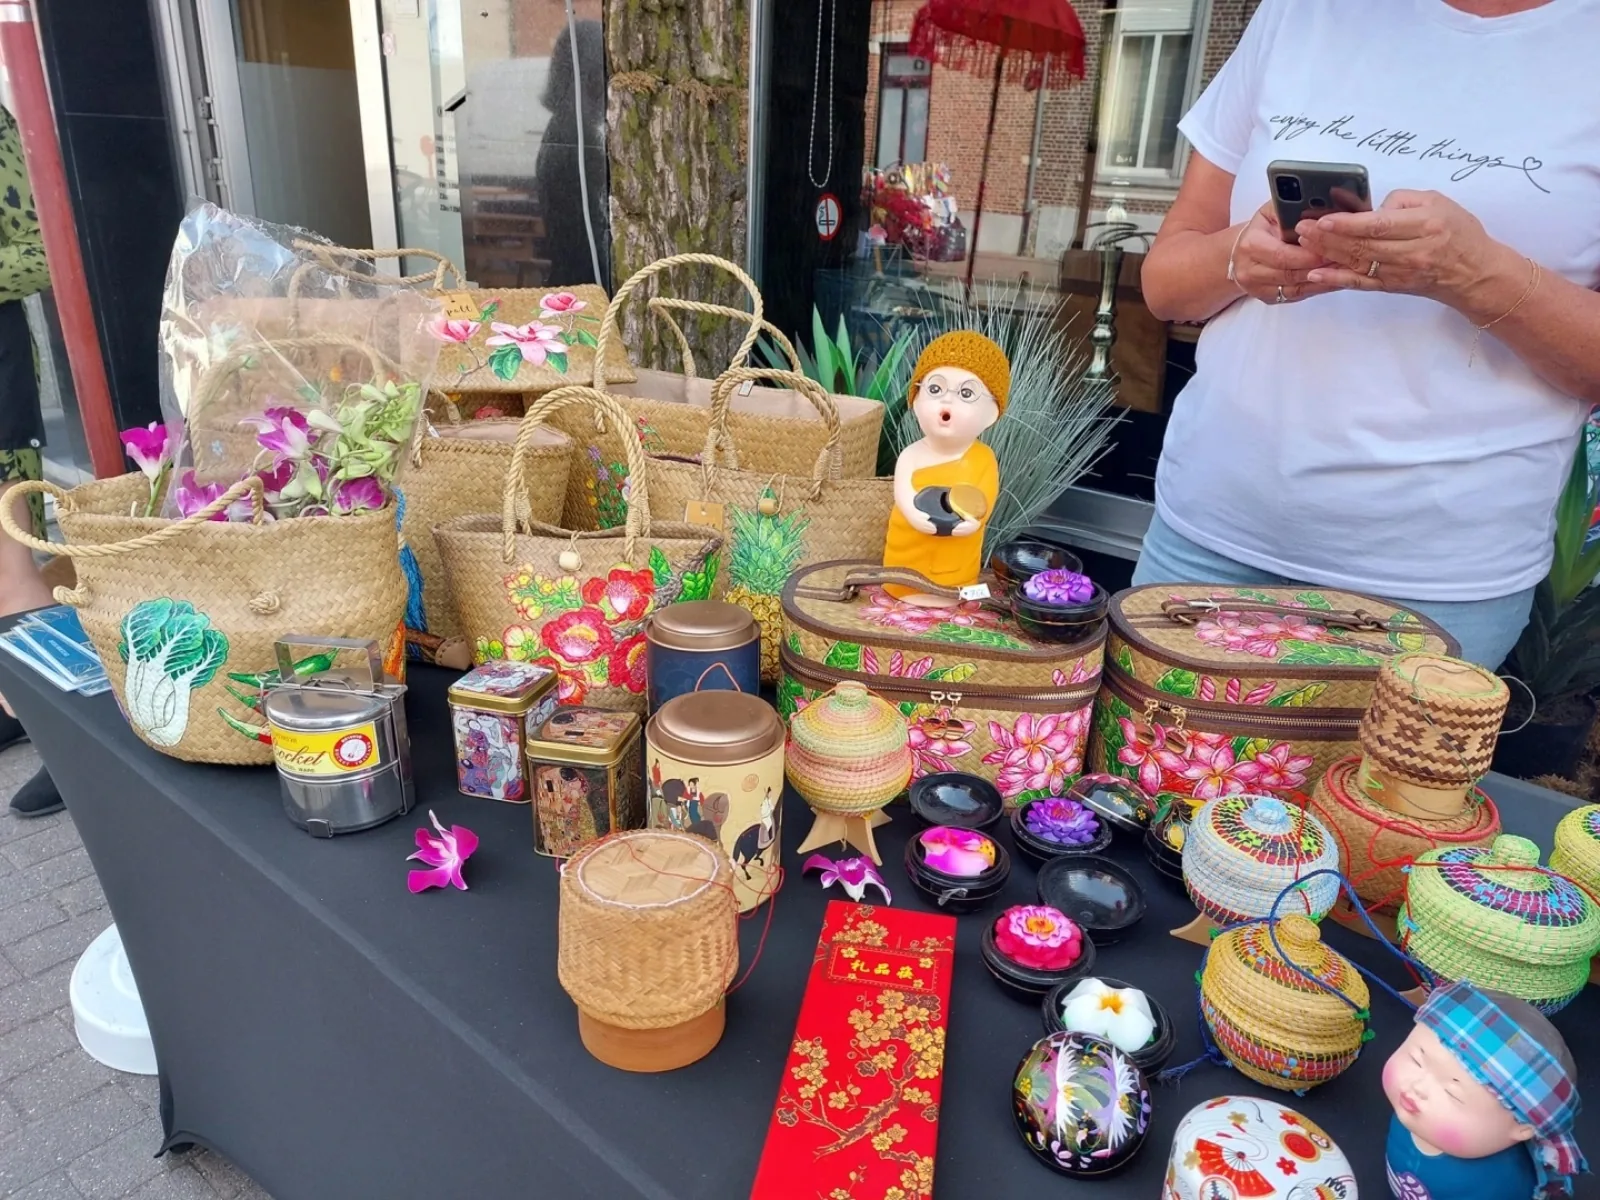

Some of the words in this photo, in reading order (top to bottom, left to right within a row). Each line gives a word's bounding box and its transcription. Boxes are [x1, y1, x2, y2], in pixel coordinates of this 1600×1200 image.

[1269, 112, 1320, 140] enjoy
[1320, 115, 1357, 140] the
[1357, 128, 1417, 155] little
[1419, 139, 1504, 182] things
